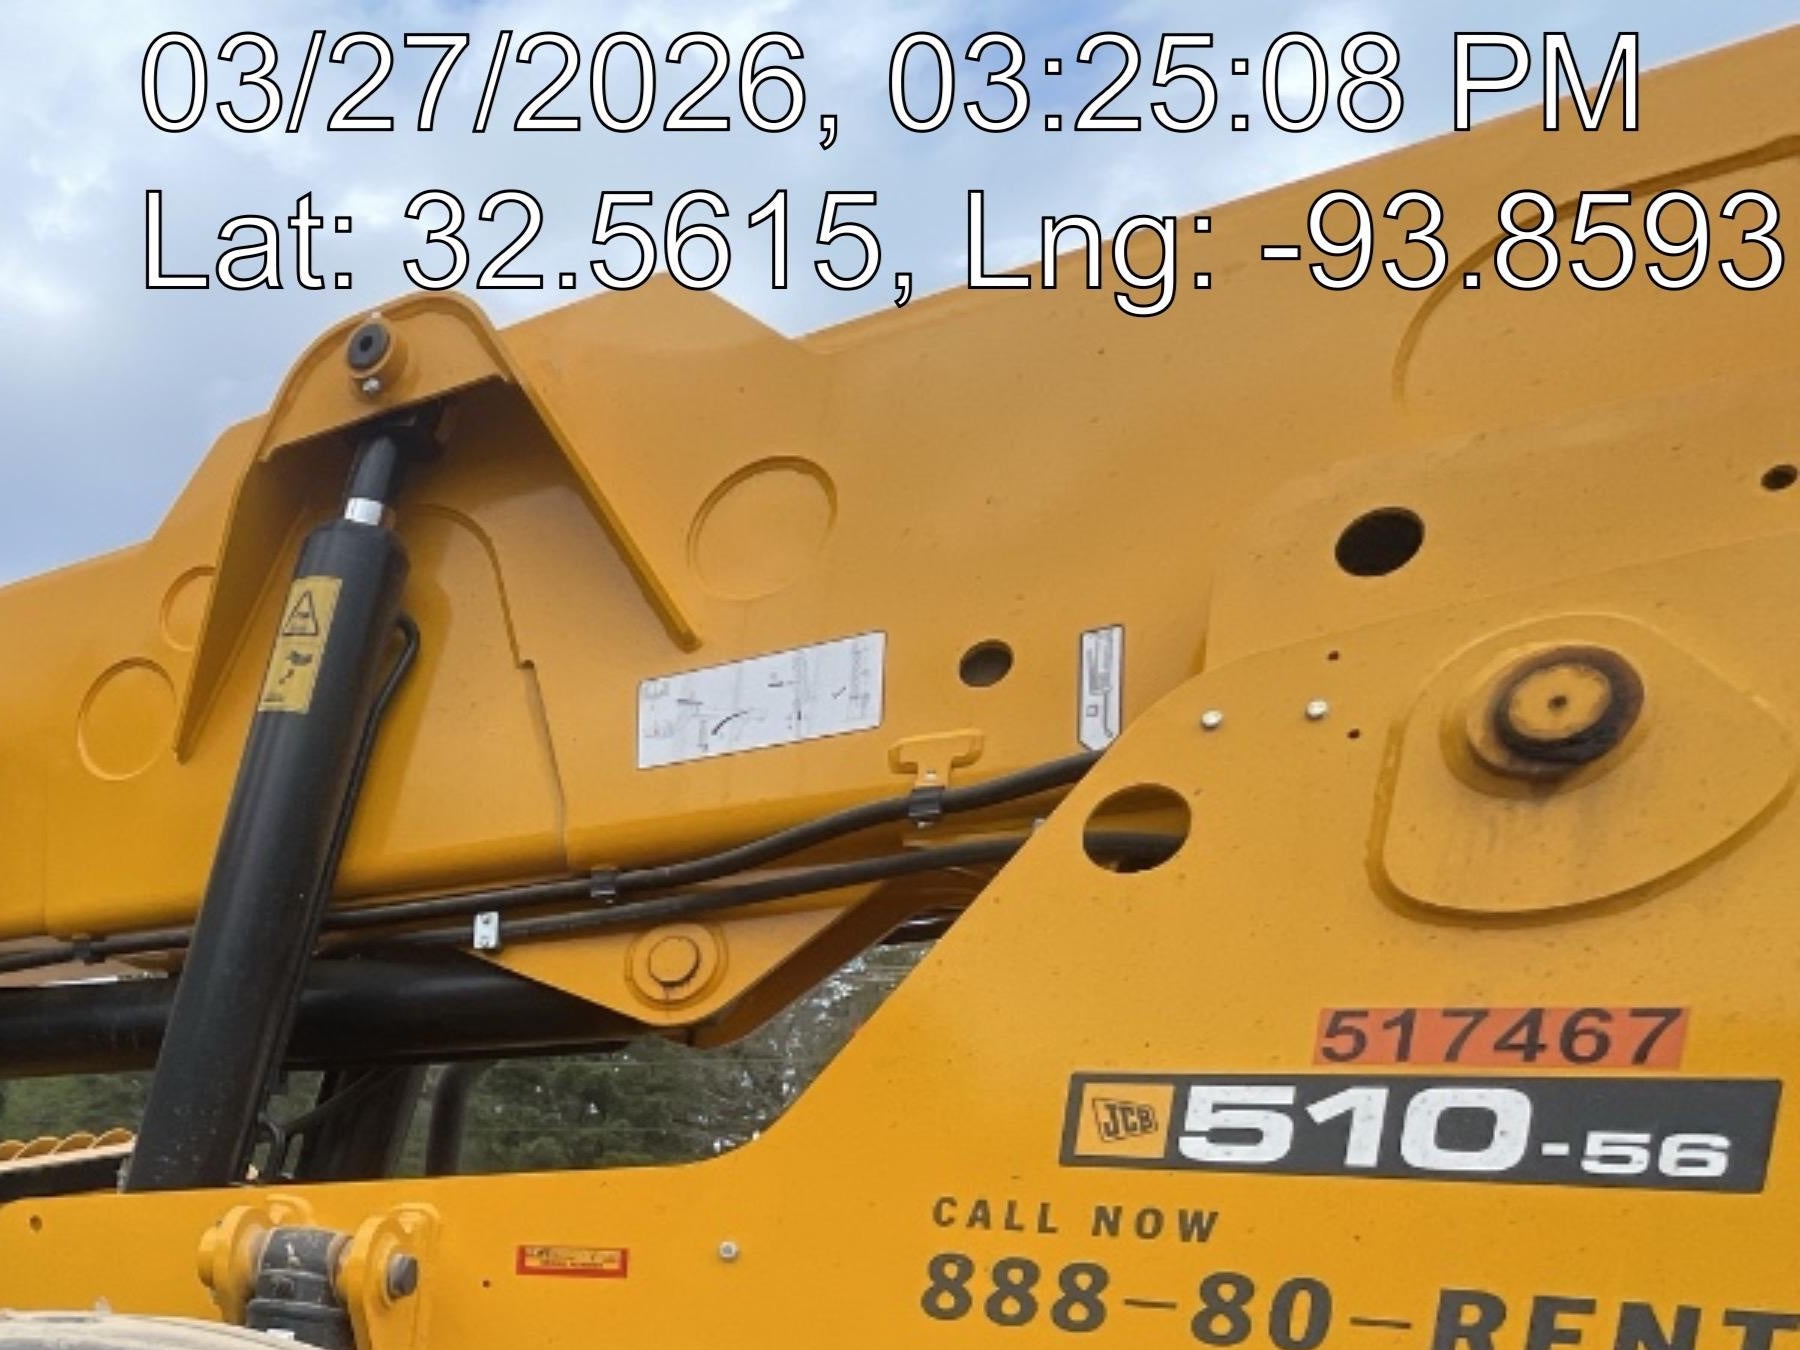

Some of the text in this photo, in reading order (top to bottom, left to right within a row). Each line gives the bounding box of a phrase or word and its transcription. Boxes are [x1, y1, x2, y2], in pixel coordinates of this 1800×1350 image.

[1320, 1007, 1682, 1065] 517467
[1101, 1102, 1155, 1139] JCB
[932, 1197, 1219, 1243] CALL NOW
